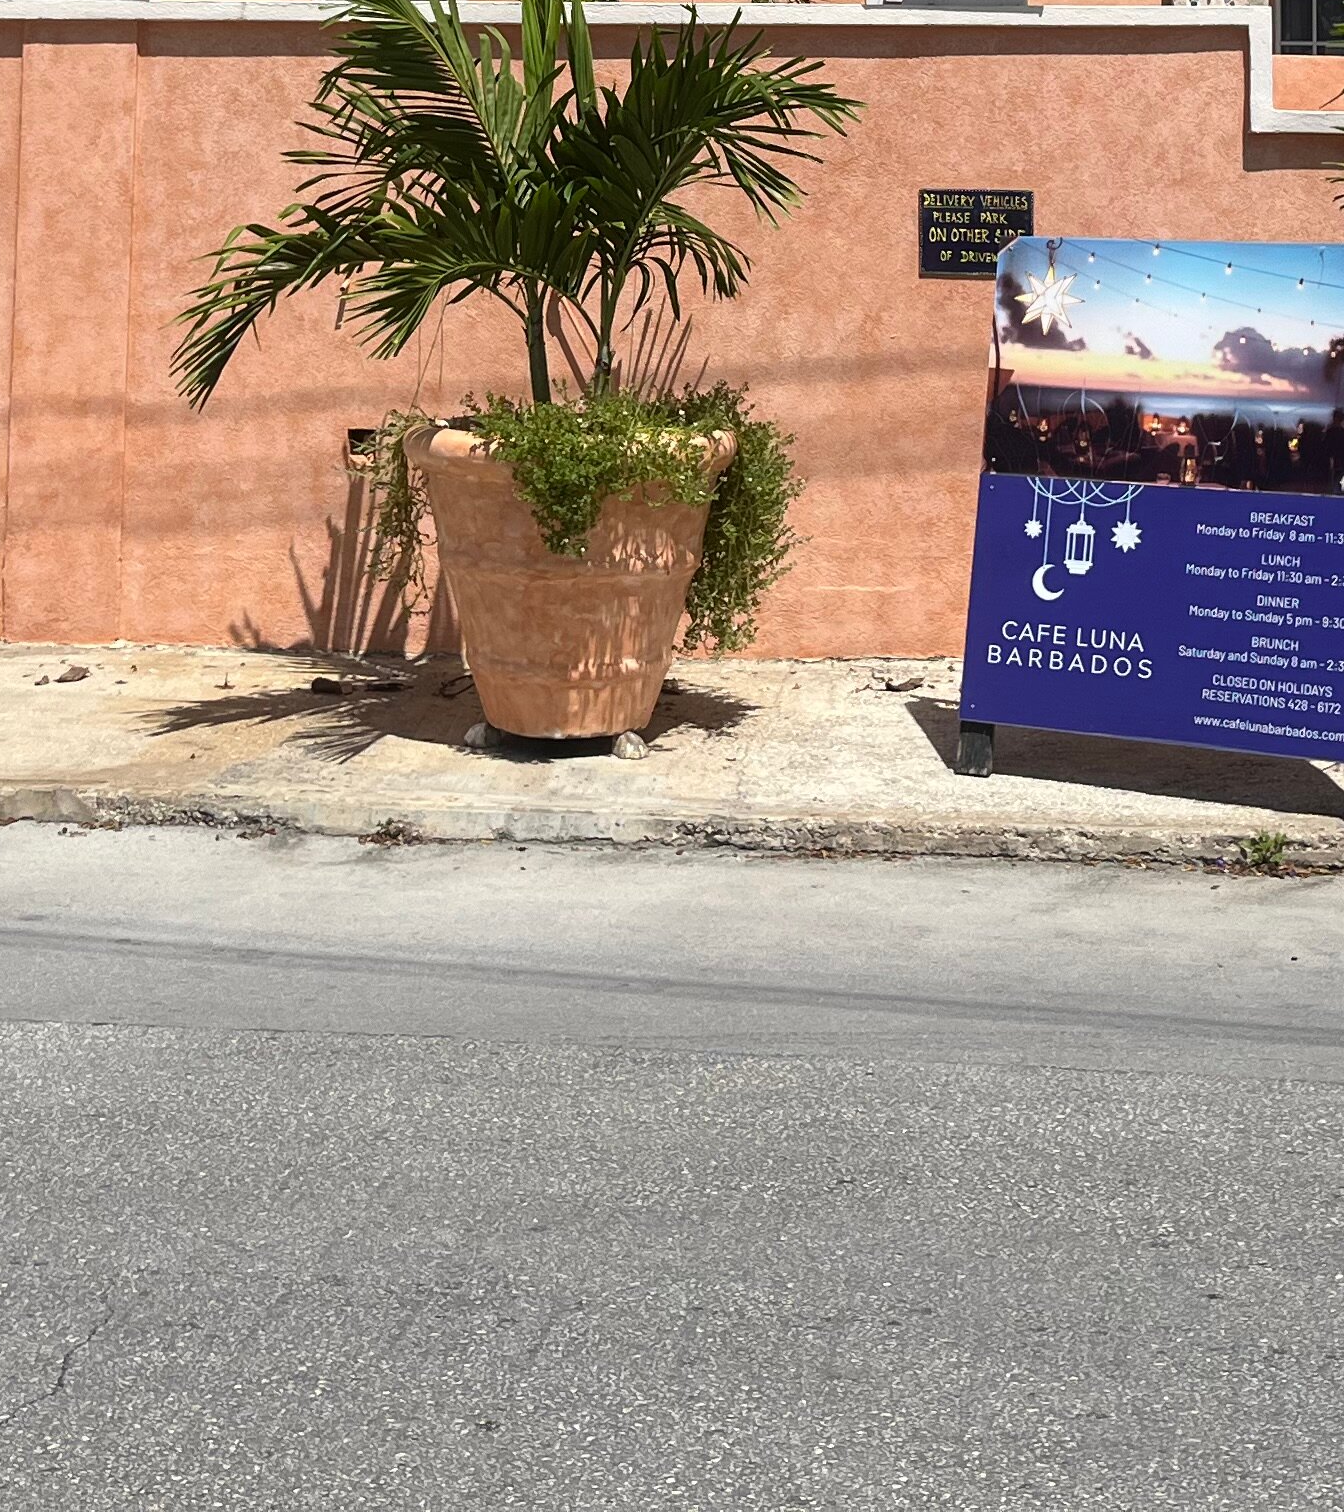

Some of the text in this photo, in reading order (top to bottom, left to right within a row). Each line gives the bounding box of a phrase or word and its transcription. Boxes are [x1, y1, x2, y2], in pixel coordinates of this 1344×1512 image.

[923, 194, 1028, 208] DELIVERY VEHICLES
[933, 211, 1008, 224] PLEASE PARK
[929, 227, 946, 242] ON
[951, 229, 990, 243] OTHER
[940, 250, 952, 261] OF
[1250, 512, 1315, 526] BREAKFAST
[1197, 524, 1237, 539] Monday
[1239, 528, 1249, 537] to
[1252, 528, 1285, 542] Friday
[1289, 530, 1296, 541] 8
[1298, 533, 1315, 542] am
[1262, 554, 1300, 567] LUNCH
[1186, 564, 1226, 579] Monday
[1229, 568, 1239, 578] to
[1242, 568, 1274, 583] Friday
[1277, 571, 1302, 583] 11:30
[1305, 576, 1321, 584] am
[1257, 595, 1299, 608] DINNER
[1189, 605, 1229, 621] Monday
[1232, 610, 1242, 620] to
[1245, 610, 1284, 625] Sunday
[1287, 613, 1293, 624] 5
[1295, 617, 1312, 627] pm
[1002, 621, 1144, 653] CAFE LUNA
[1252, 637, 1298, 651] BRUNCH
[987, 644, 1152, 679] BARBADOS
[1179, 645, 1226, 662] Saturday
[1228, 652, 1247, 662] and
[1250, 652, 1289, 669] Sunday
[1291, 656, 1298, 667] 8
[1300, 660, 1317, 669] am
[1213, 675, 1333, 698] CLOSED ON HOLIDAYS
[1202, 688, 1285, 708] RESERVATIONS
[1288, 699, 1308, 711] 428
[1318, 702, 1341, 714] 6172
